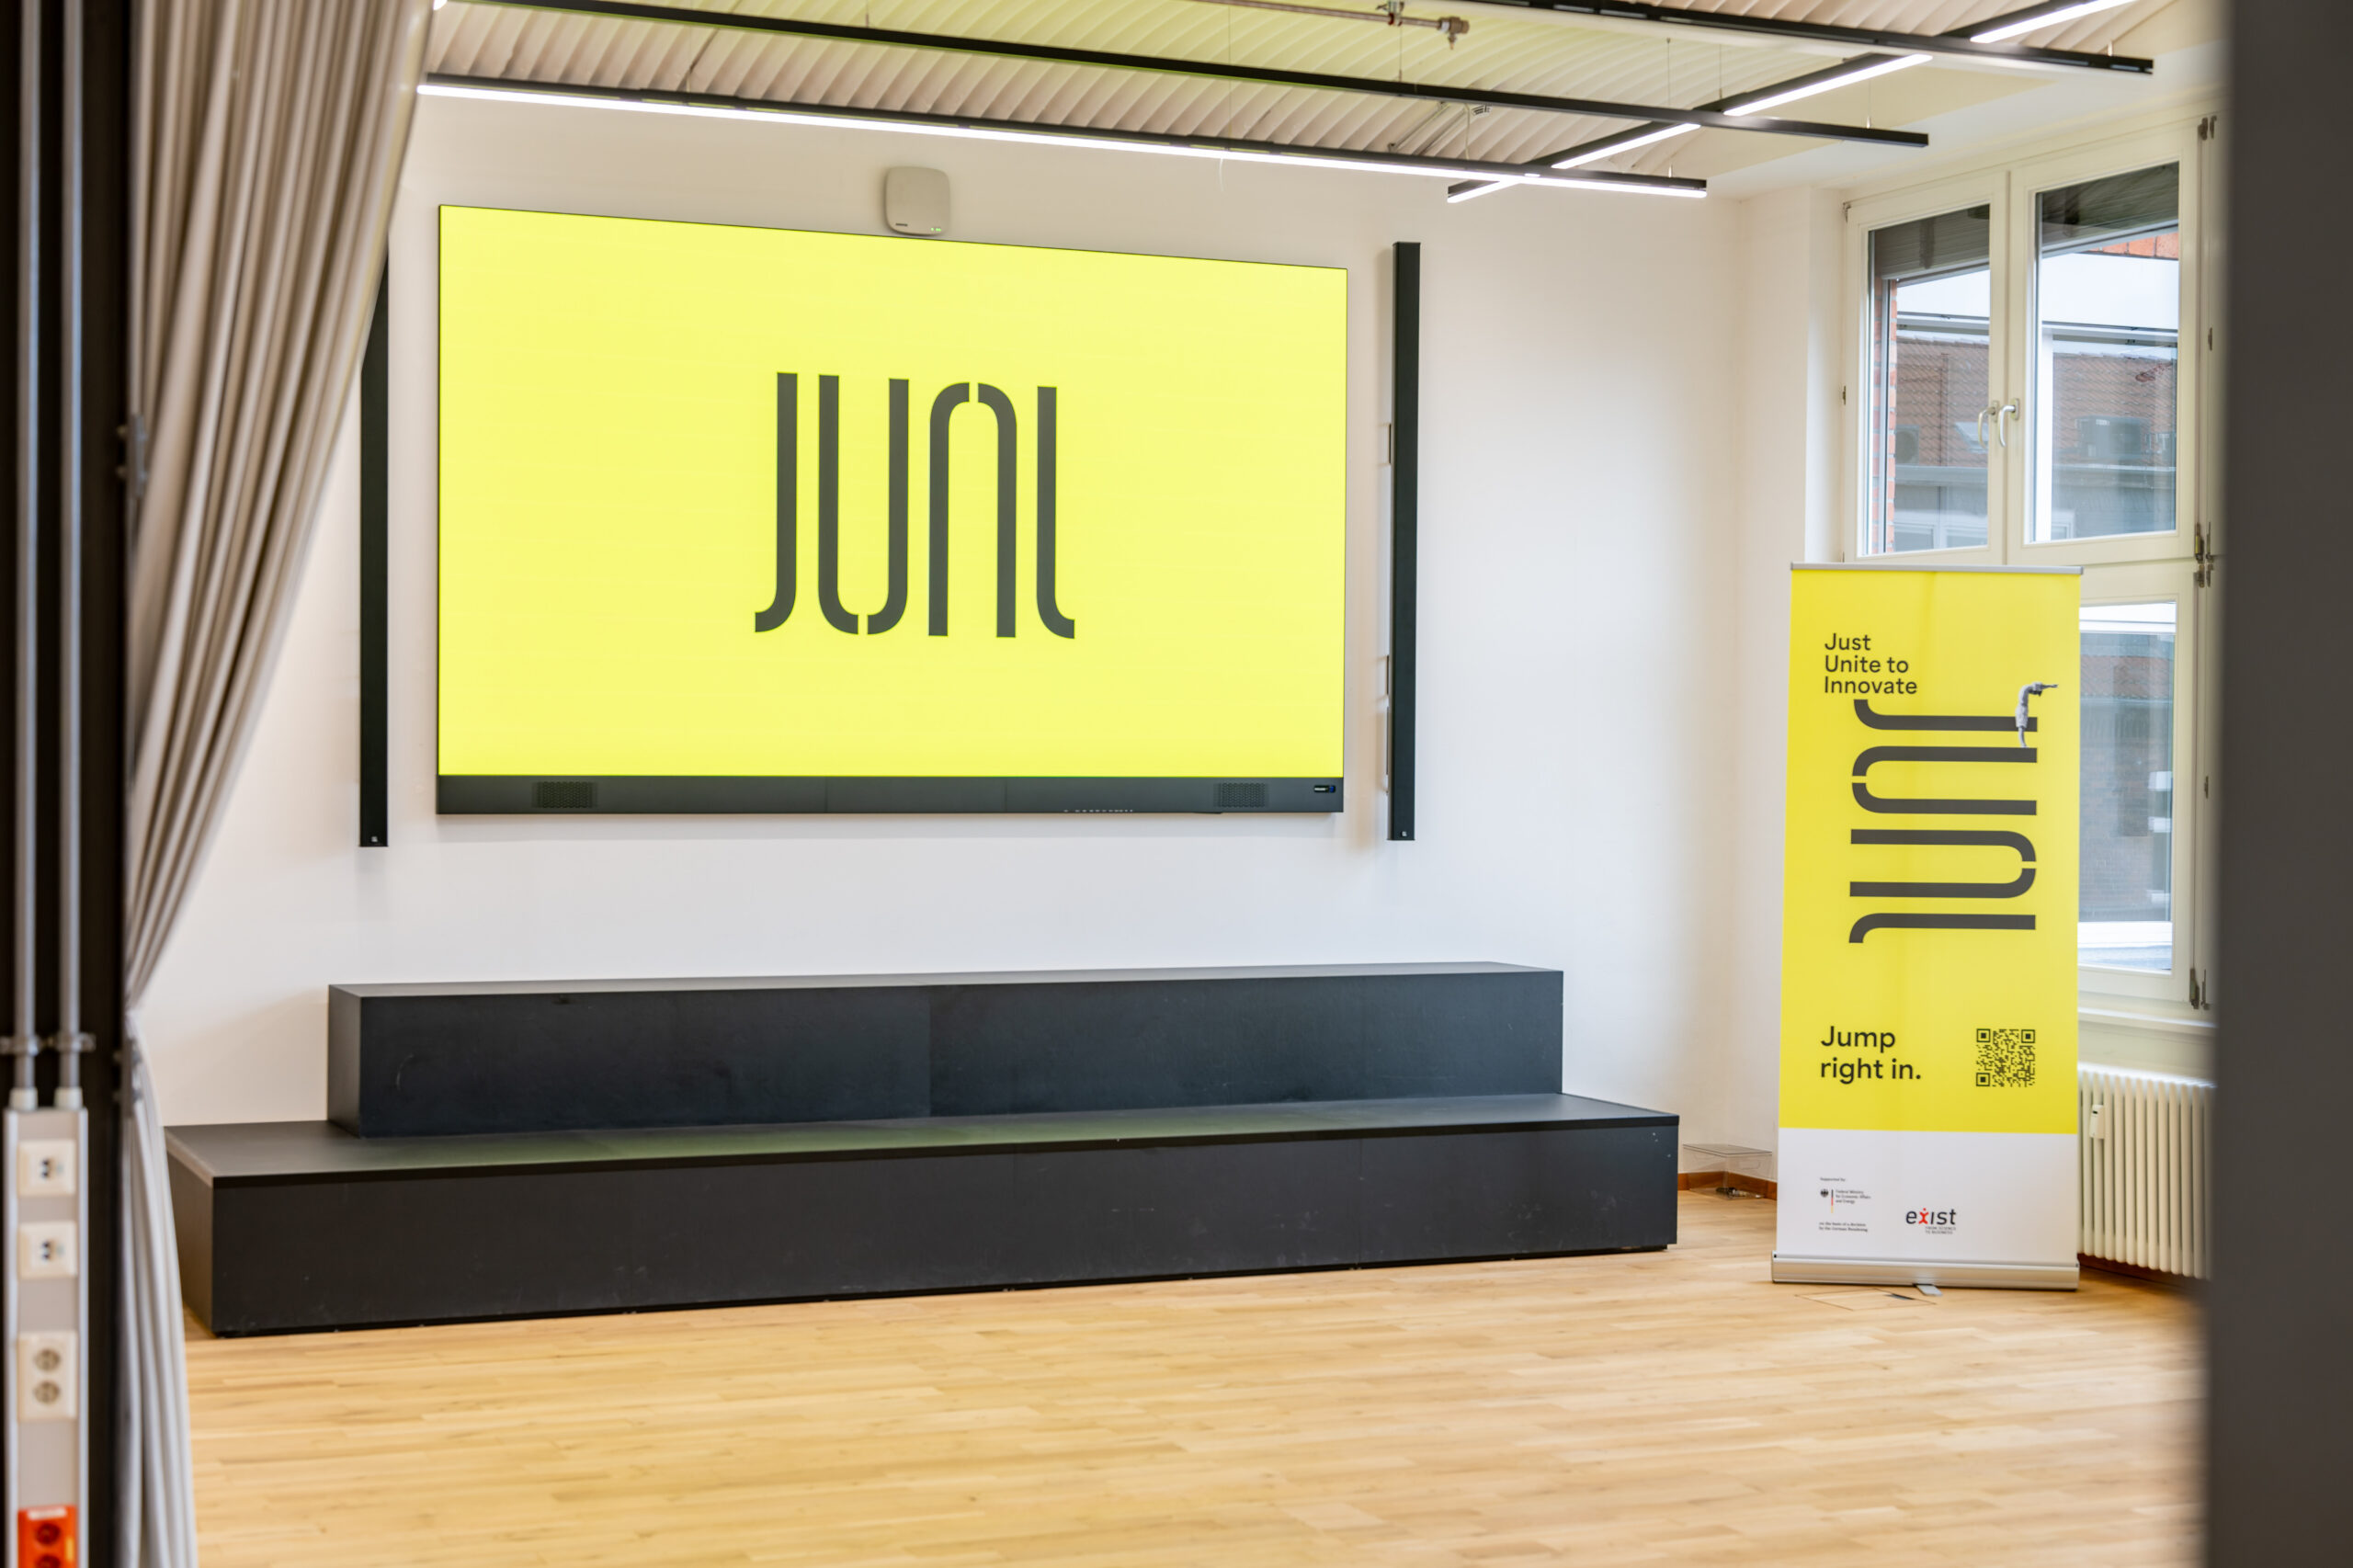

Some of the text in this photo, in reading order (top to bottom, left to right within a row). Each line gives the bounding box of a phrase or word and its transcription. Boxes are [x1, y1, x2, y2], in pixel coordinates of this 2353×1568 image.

[1825, 633, 1870, 651] Just
[1825, 655, 1908, 673] Unite to
[1825, 676, 1916, 694] Innovate
[1821, 1026, 1895, 1053] Jump
[1822, 1057, 1920, 1085] right in.
[1906, 1208, 1956, 1225] exist
